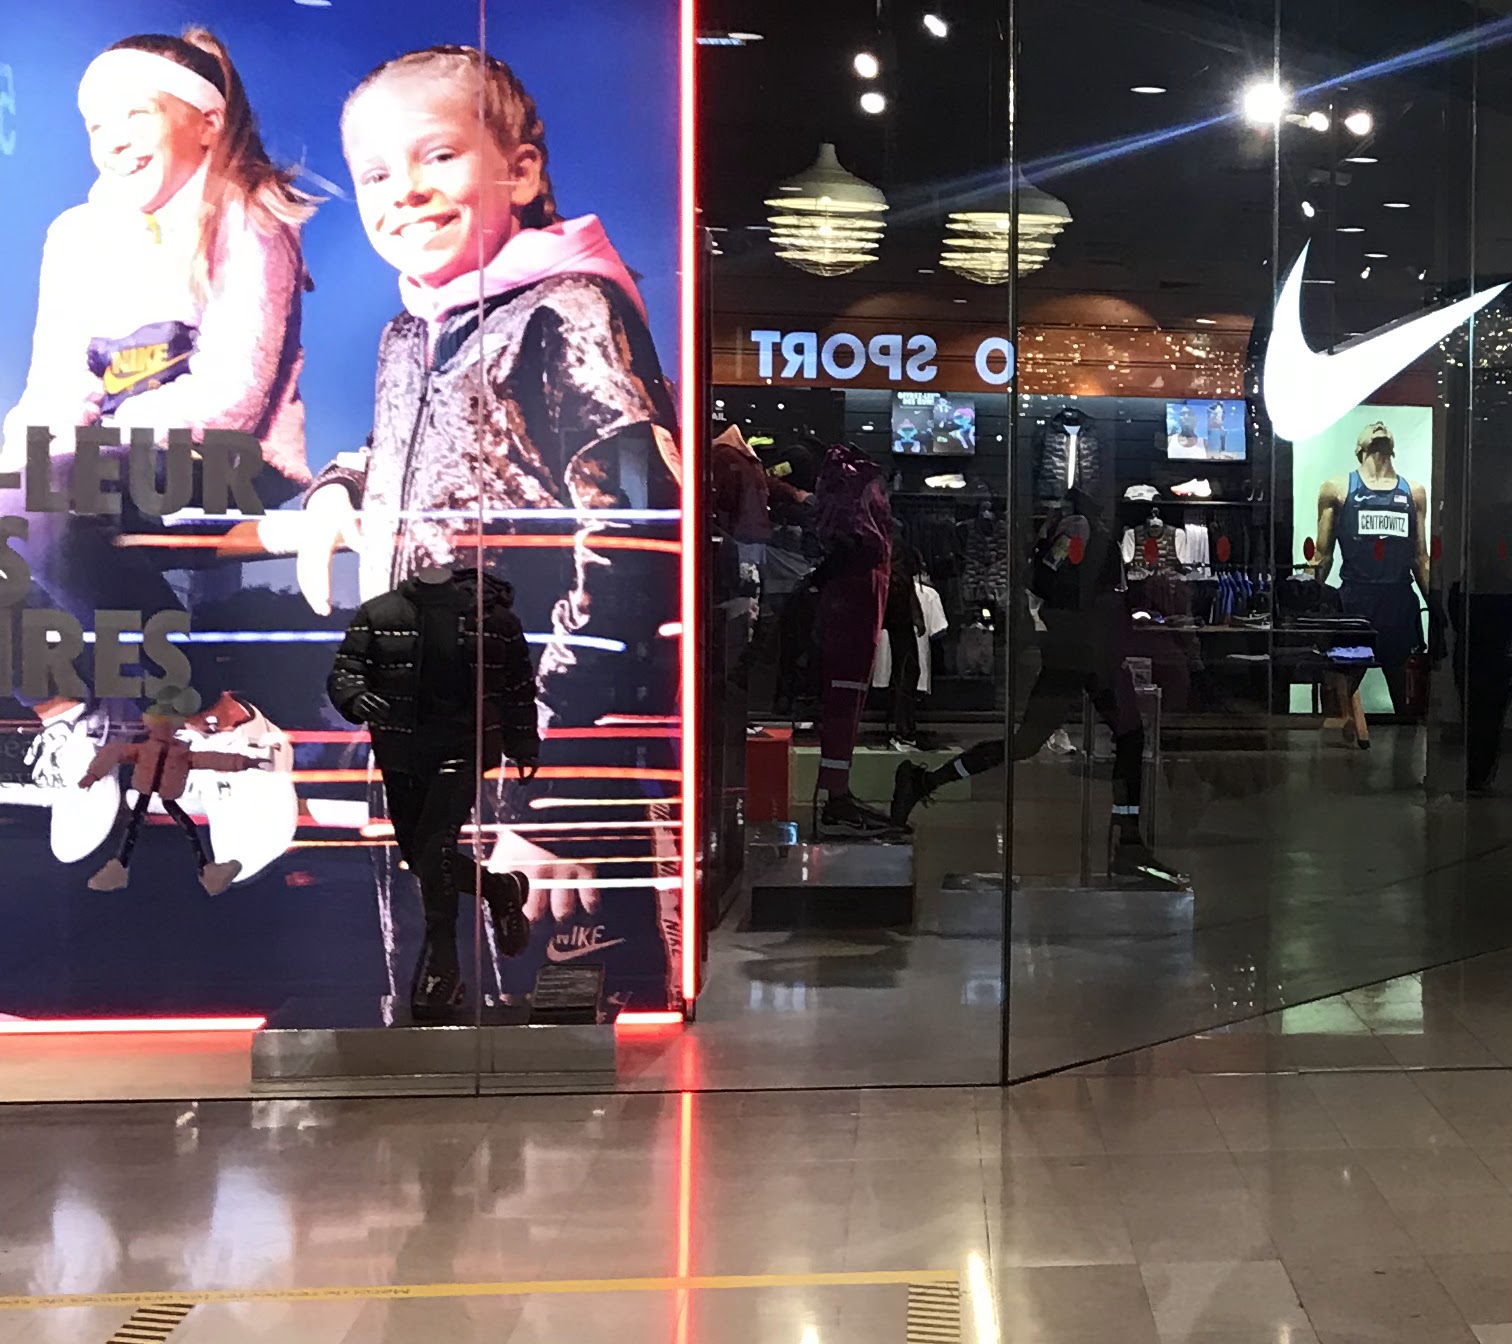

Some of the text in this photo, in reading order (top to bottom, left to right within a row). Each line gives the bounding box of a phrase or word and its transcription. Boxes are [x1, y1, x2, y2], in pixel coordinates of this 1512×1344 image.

[111, 343, 168, 374] NIKE
[1361, 514, 1406, 533] CENTROWITZ
[556, 925, 605, 947] NIKE
